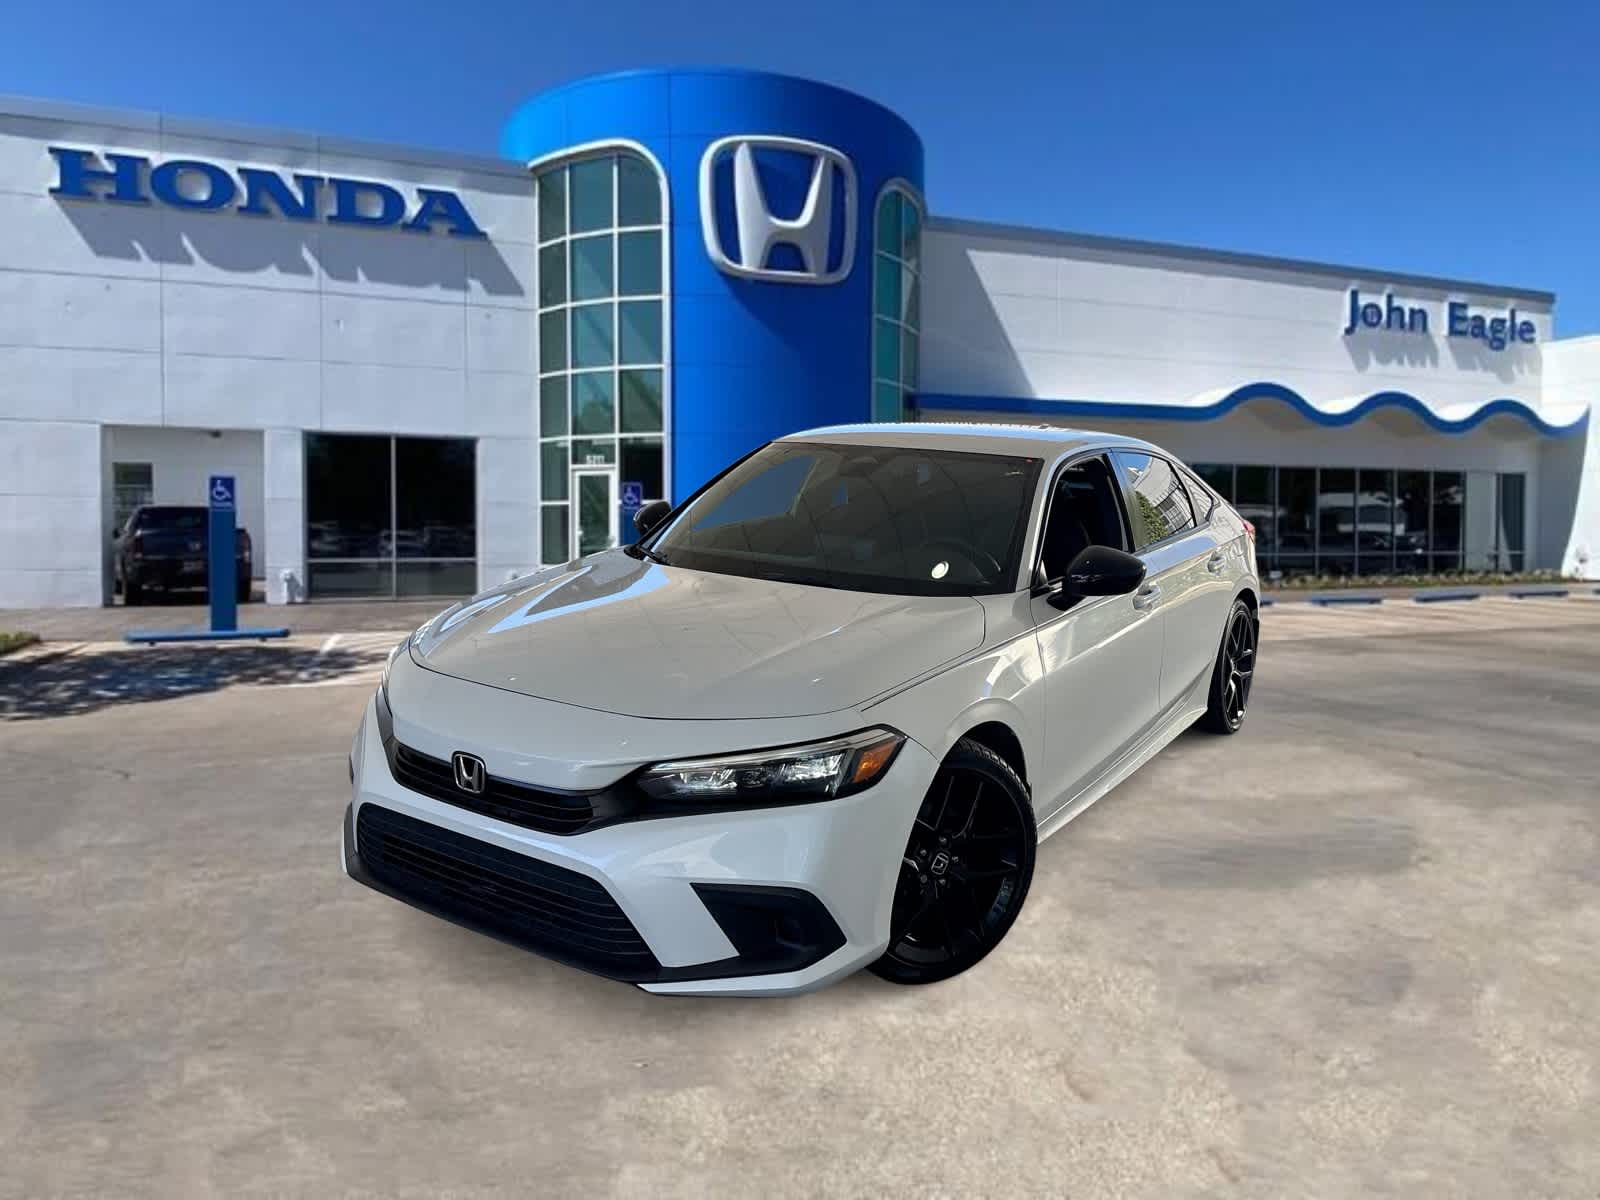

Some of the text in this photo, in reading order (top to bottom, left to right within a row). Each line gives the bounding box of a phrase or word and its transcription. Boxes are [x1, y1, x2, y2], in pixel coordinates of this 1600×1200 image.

[49, 145, 488, 239] HONDA
[1344, 289, 1536, 351] John Eagle
